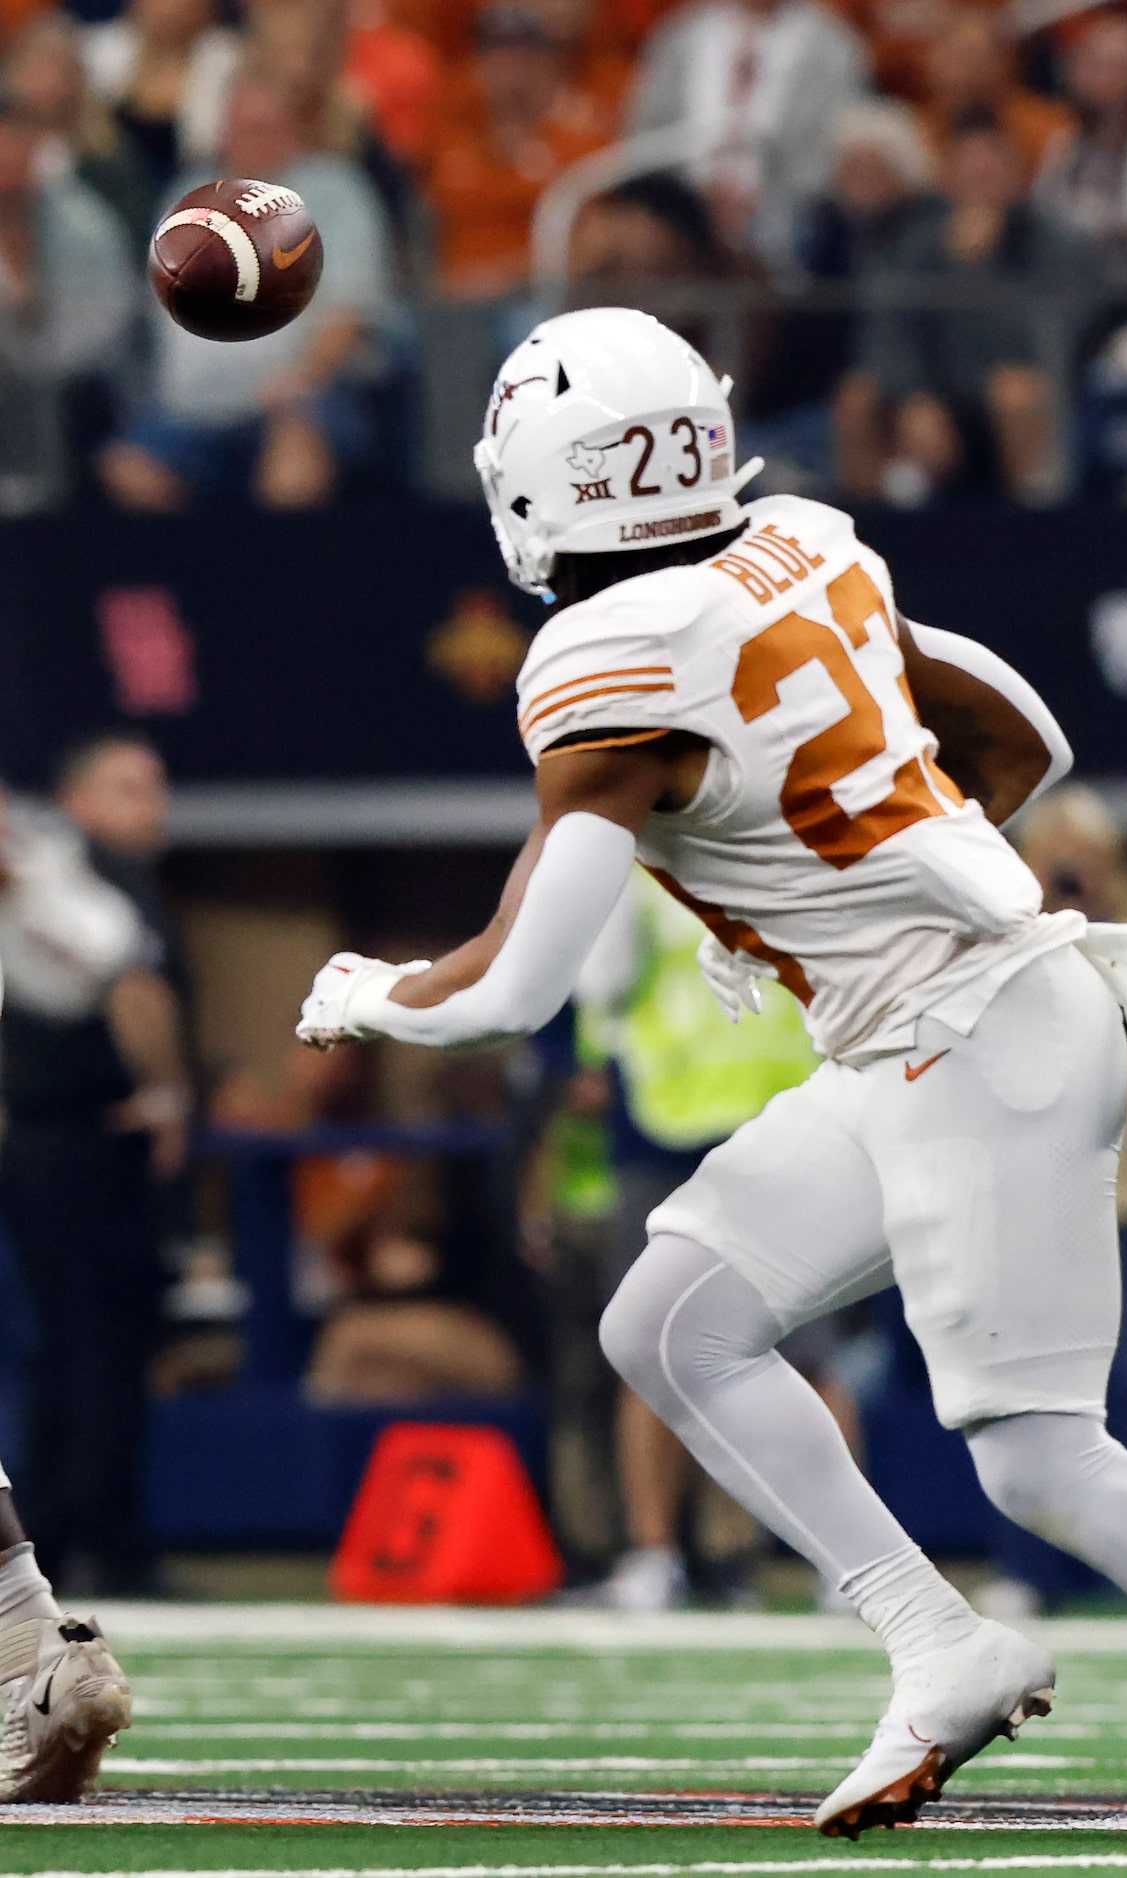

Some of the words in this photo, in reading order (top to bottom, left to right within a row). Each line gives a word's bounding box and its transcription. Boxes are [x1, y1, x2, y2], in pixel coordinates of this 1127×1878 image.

[622, 416, 703, 498] 23
[570, 478, 617, 504] XII
[618, 509, 722, 543] LONGHORNS
[710, 524, 826, 606] BLUE
